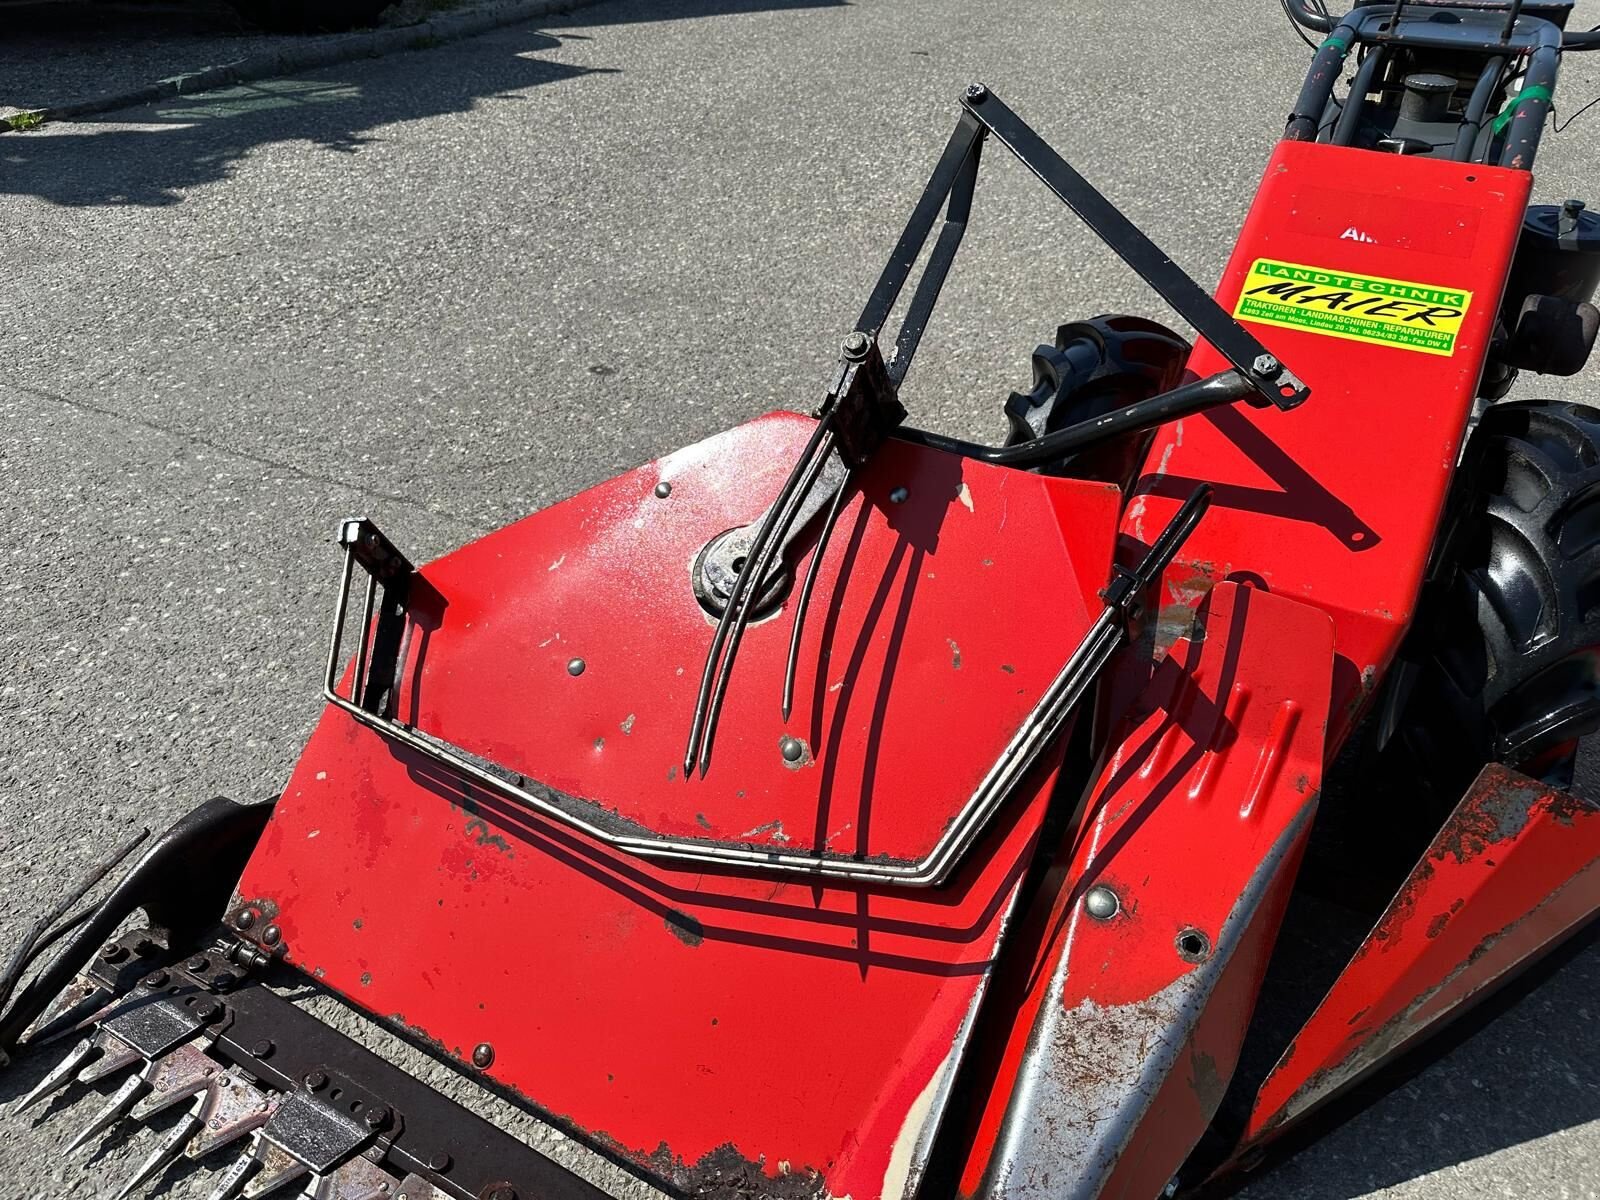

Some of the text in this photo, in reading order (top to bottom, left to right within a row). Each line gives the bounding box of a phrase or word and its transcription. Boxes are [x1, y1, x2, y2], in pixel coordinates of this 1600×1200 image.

[1244, 282, 1464, 326] MAIER
[1259, 264, 1461, 306] LANDTECHNIK
[1245, 299, 1451, 342] TRAKTOREN LANDMASCHINEN REPARATUREN
[1260, 310, 1275, 318] Zell
[1274, 313, 1286, 321] am
[1309, 319, 1334, 329] Lindau
[1348, 326, 1361, 335] Tel.
[1411, 337, 1425, 345] Fax
[1426, 339, 1441, 348] DW
